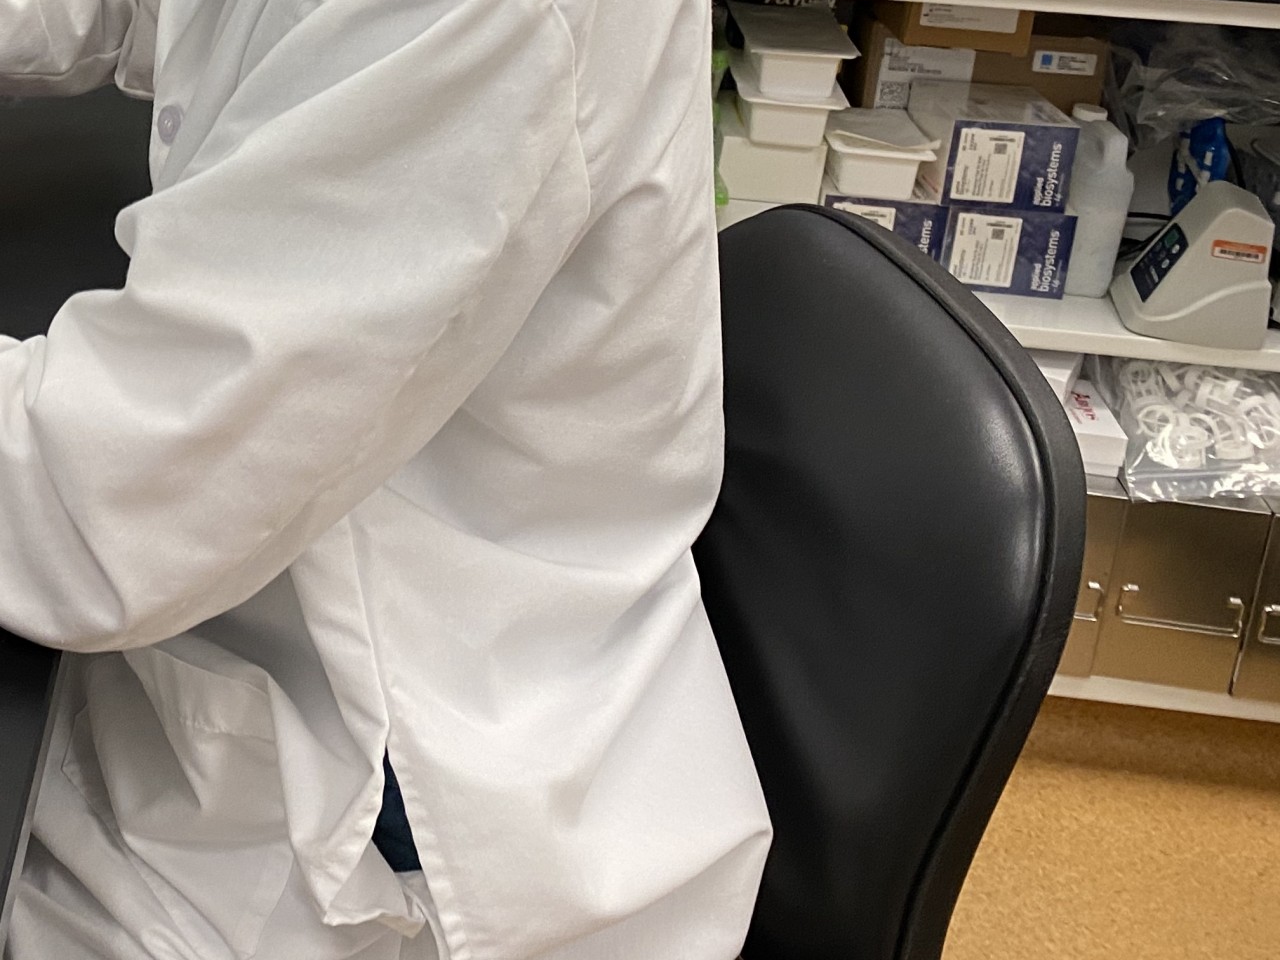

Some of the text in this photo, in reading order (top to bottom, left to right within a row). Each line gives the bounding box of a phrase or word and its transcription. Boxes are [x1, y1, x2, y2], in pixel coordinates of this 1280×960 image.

[1032, 177, 1044, 206] applied
[1040, 142, 1063, 208] biosystems
[1030, 263, 1042, 292] applied
[1038, 229, 1061, 293] biosystems
